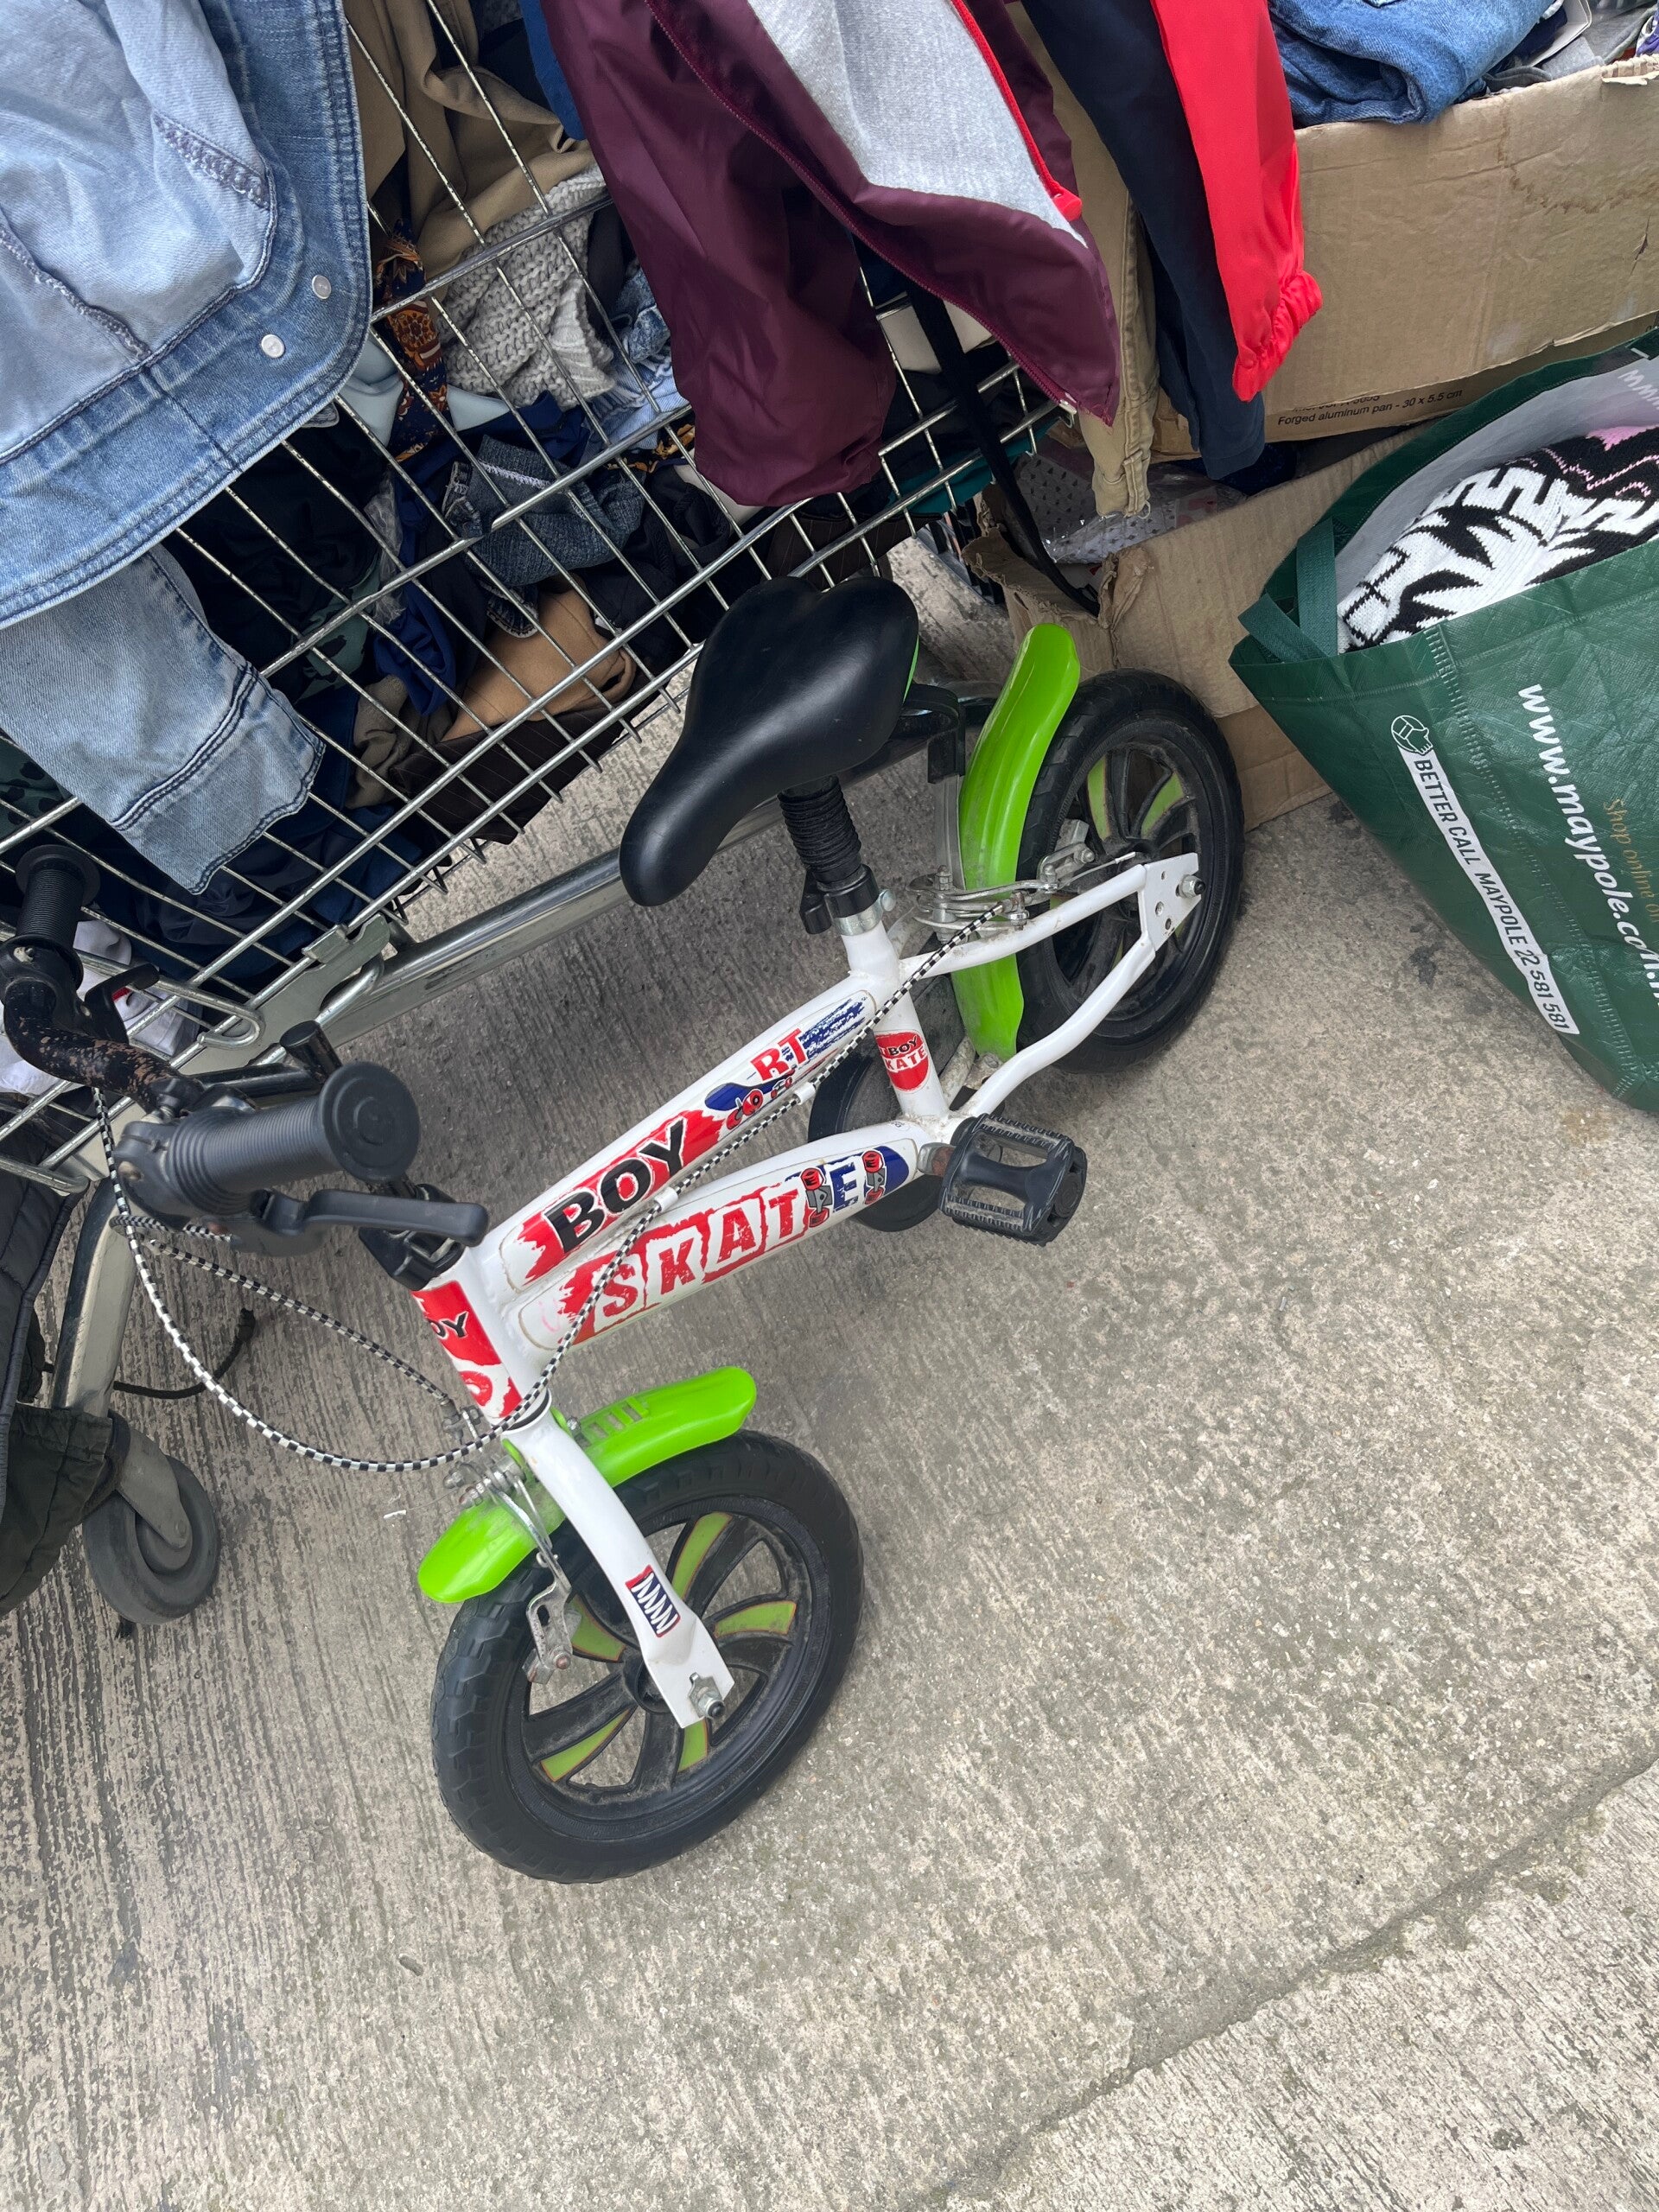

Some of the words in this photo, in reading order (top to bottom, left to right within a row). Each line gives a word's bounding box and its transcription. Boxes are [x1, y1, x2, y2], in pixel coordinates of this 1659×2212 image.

[1278, 412, 1315, 425] Forged
[1318, 406, 1370, 421] aluminum
[1372, 404, 1393, 415] pan
[1402, 397, 1416, 408] 30
[1427, 391, 1446, 404] 5.5
[1446, 389, 1463, 398] cm
[1414, 759, 1459, 822] BETTER
[1448, 826, 1481, 865] CALL
[1474, 873, 1528, 945] MAYPOLE
[1515, 949, 1540, 966] 22
[1530, 969, 1554, 998] 581
[1543, 1002, 1570, 1029] 581
[1603, 798, 1631, 844] Shop
[1623, 849, 1654, 898] online
[888, 1035, 917, 1056] BOY
[543, 1117, 684, 1254] BOY
